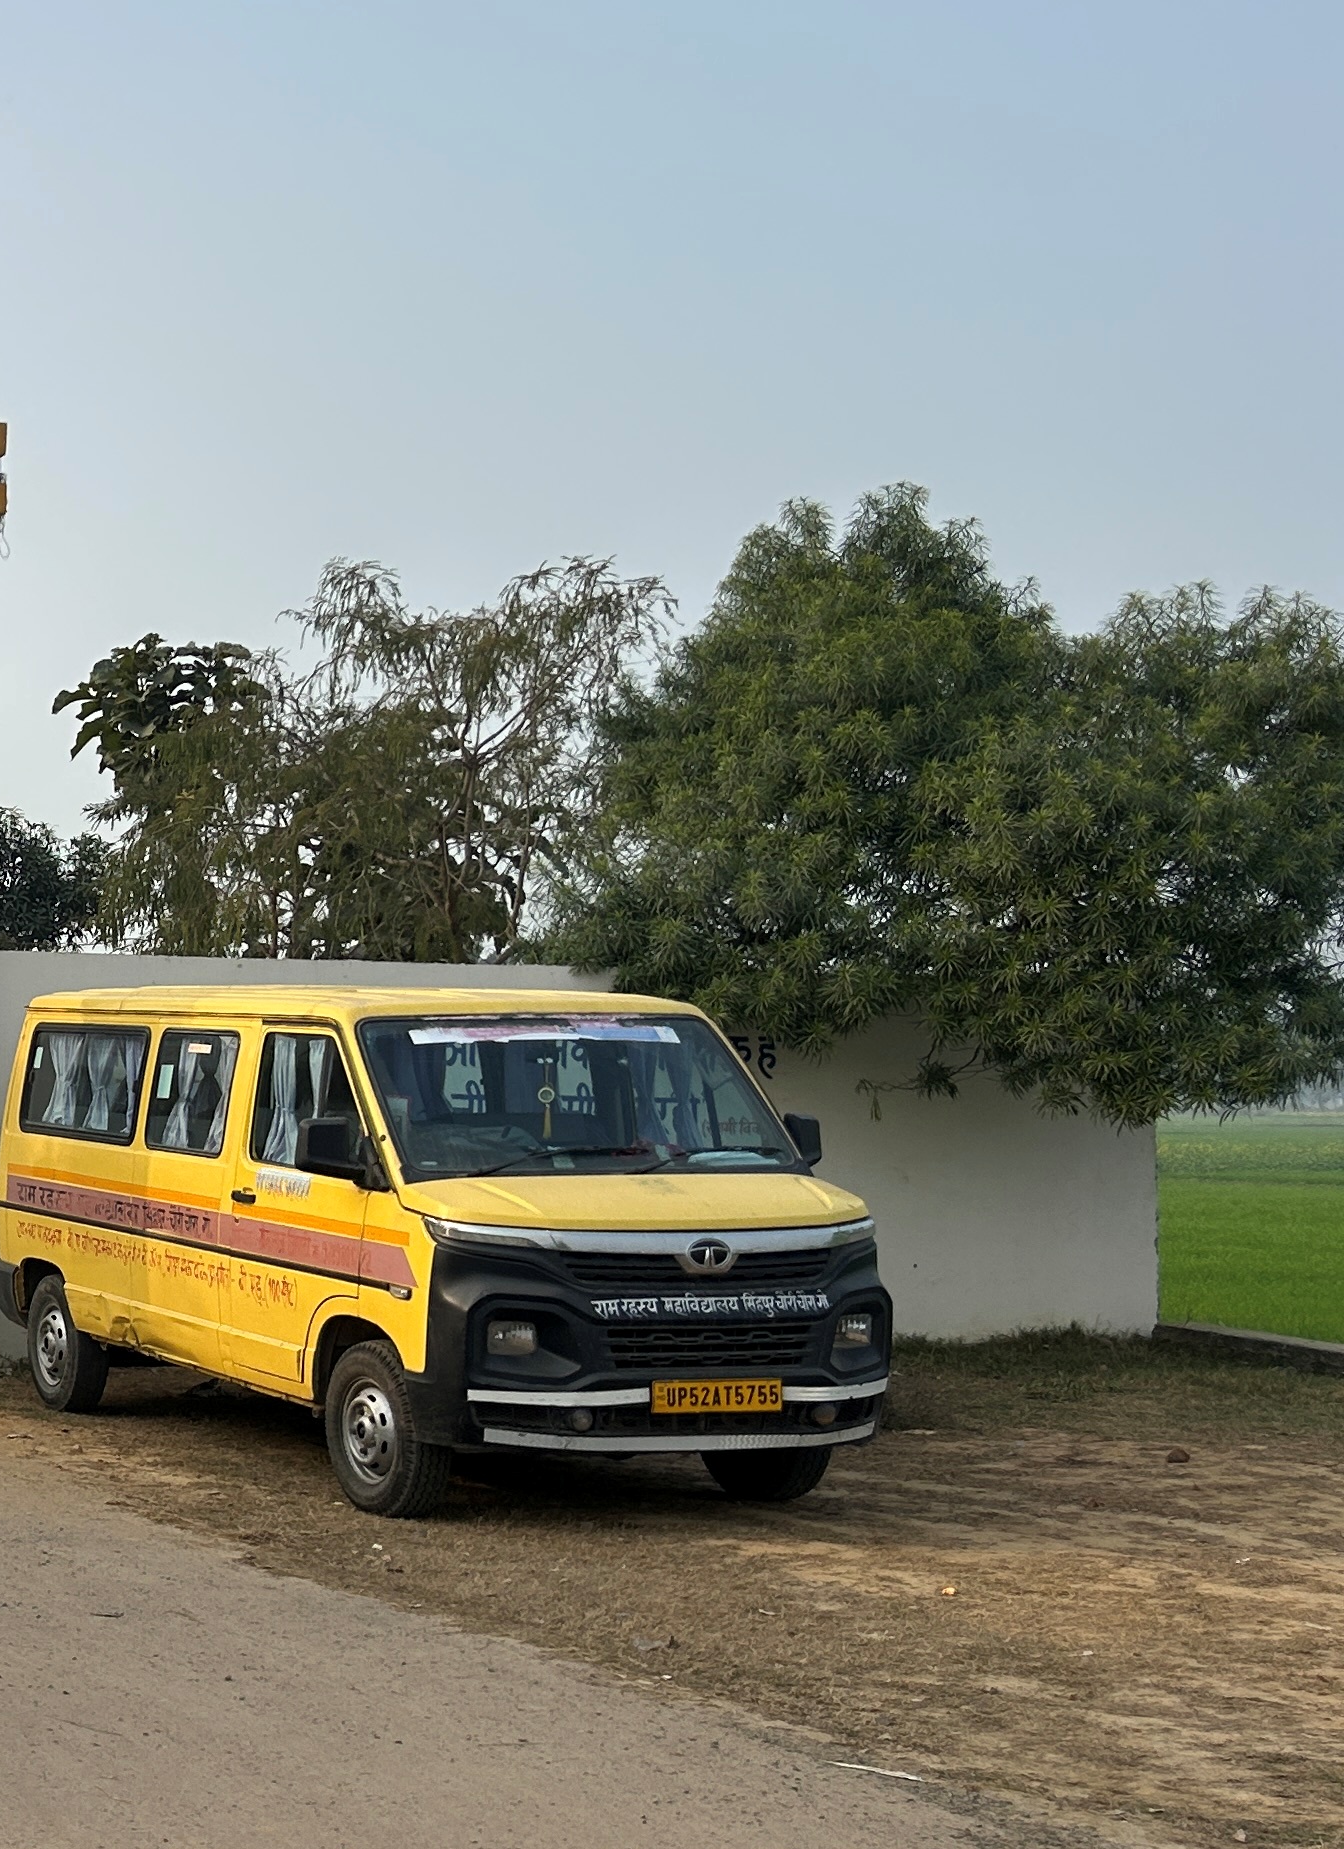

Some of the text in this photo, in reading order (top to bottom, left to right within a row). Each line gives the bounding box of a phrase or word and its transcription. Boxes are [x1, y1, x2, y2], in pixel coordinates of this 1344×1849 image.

[591, 1299, 620, 1319] राम
[619, 1298, 659, 1319] रहस्य
[660, 1292, 739, 1316] महाविद्यालय
[666, 1384, 779, 1408] UP52AT5755
